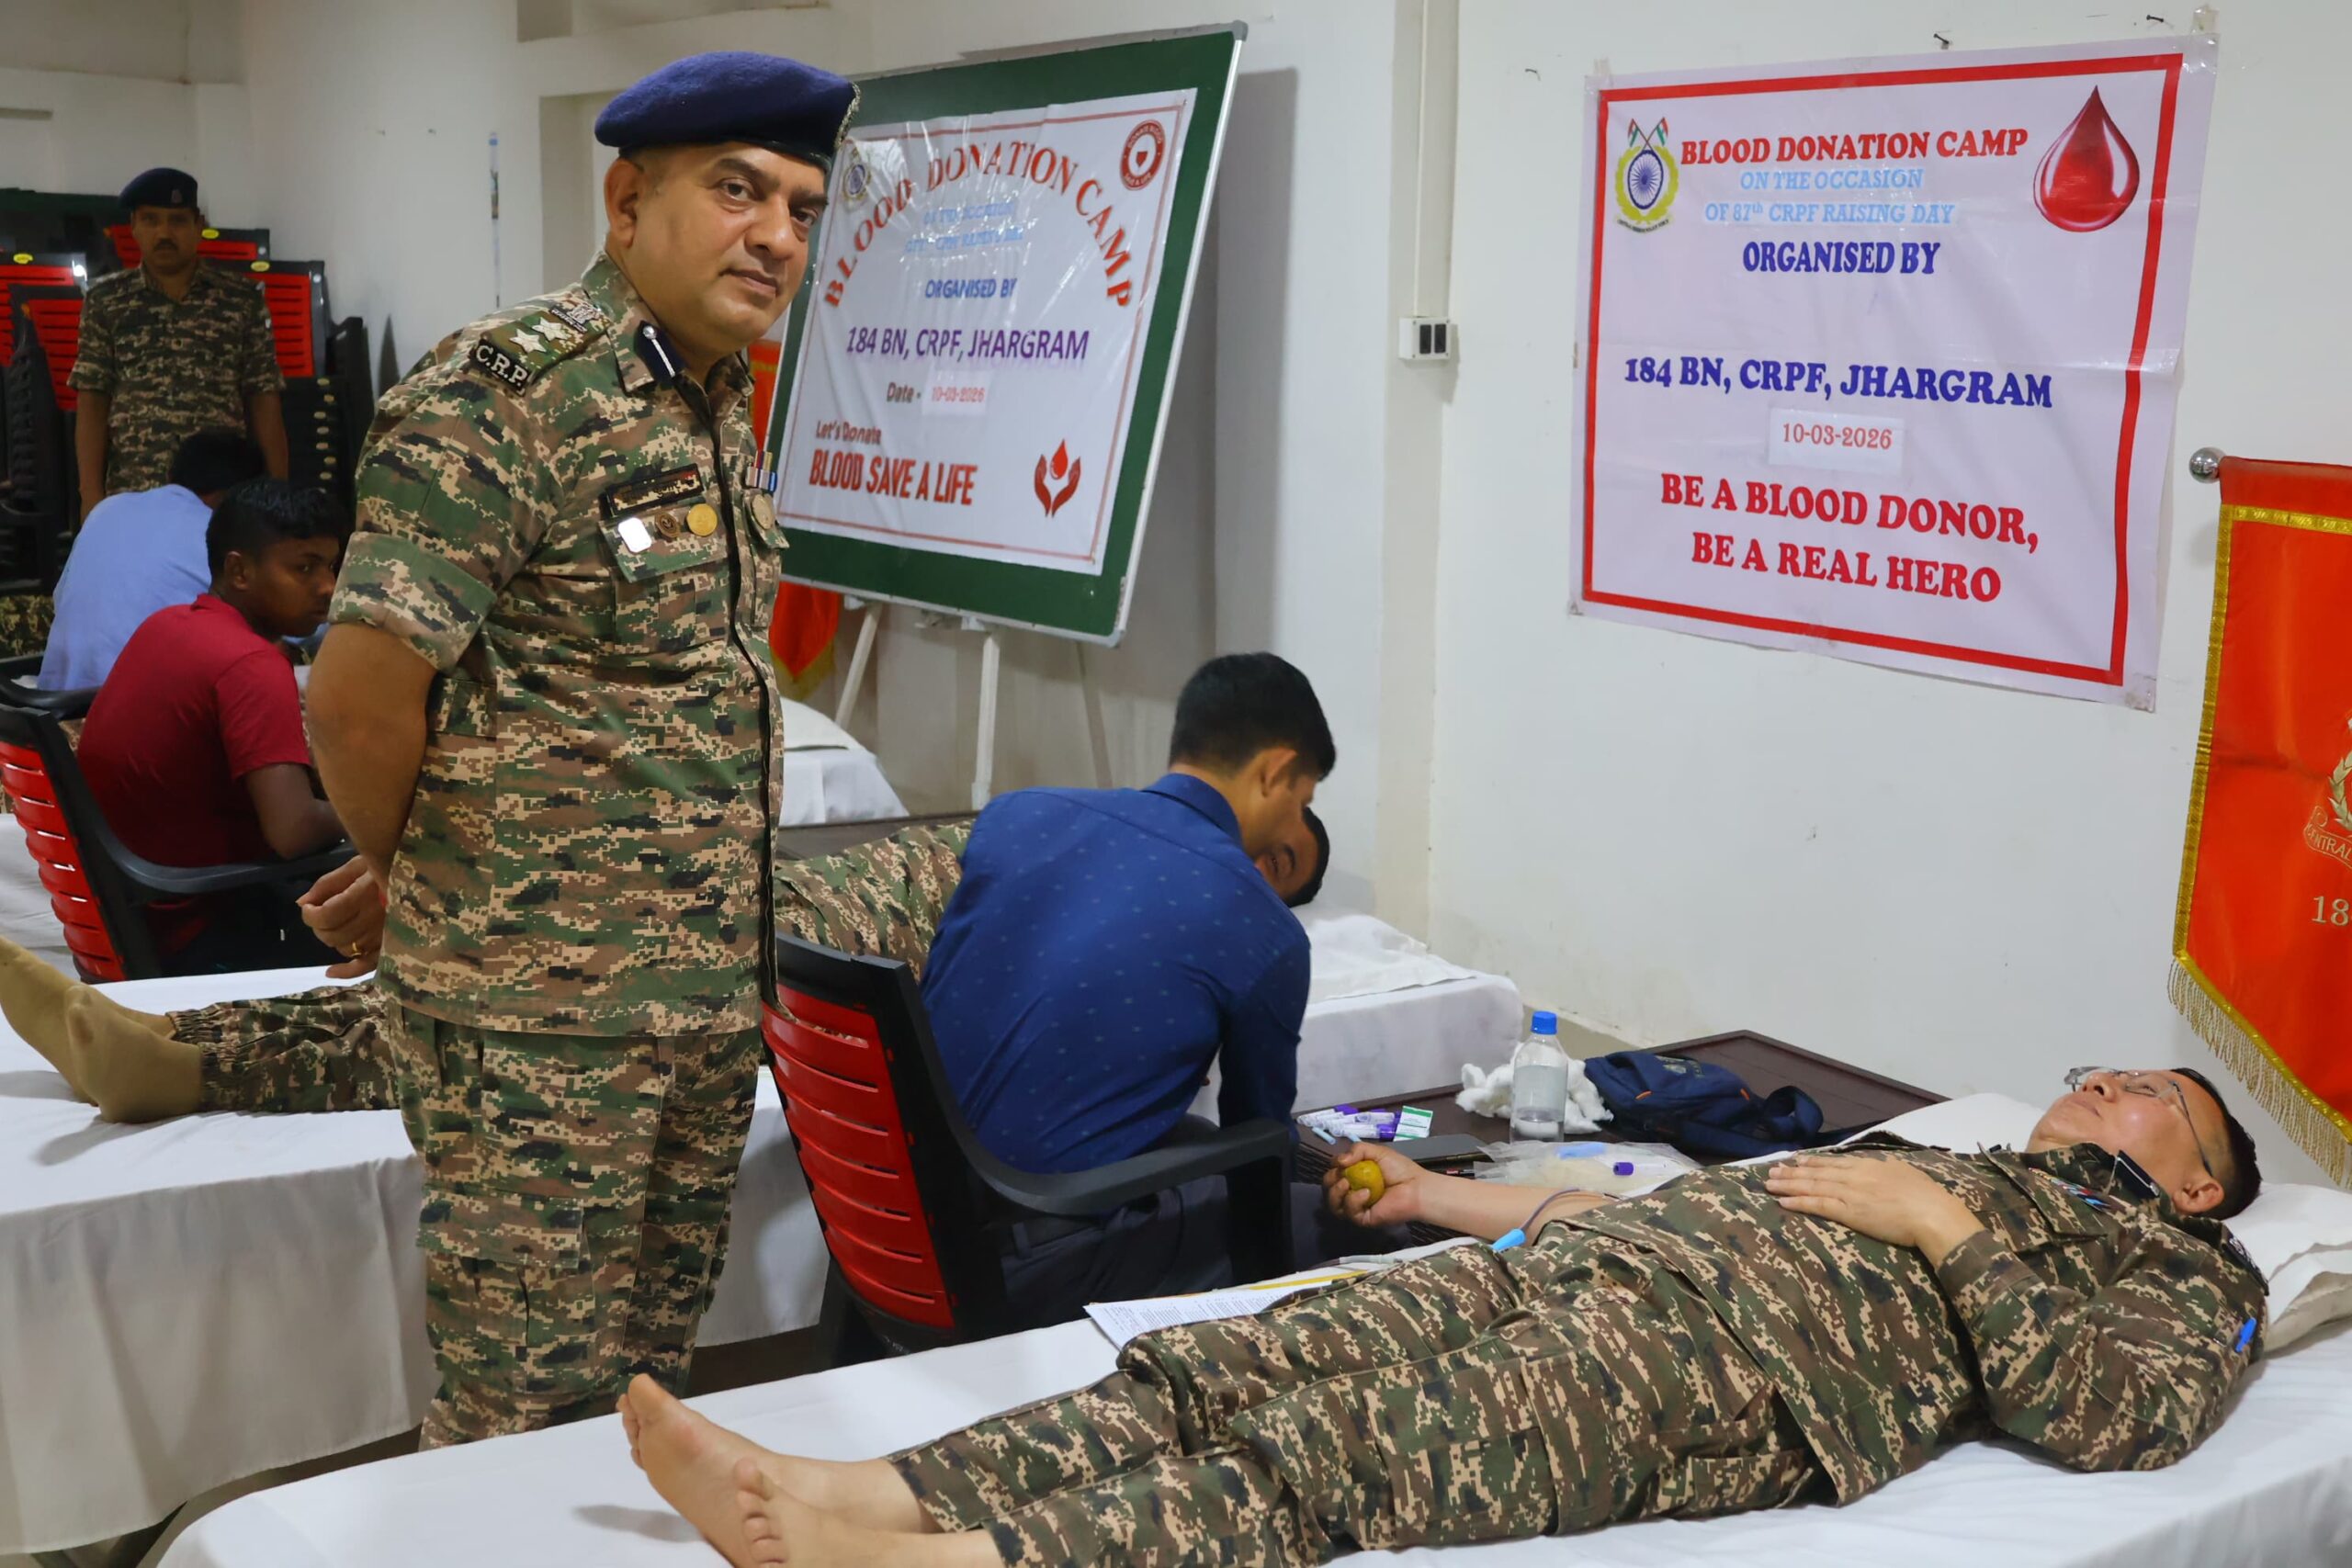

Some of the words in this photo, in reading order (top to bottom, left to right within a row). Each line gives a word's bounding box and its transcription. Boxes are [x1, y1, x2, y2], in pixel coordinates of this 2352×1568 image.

[1680, 138, 1770, 164] BLOOD
[1776, 131, 1930, 162] DONATION
[1936, 129, 2029, 157] CAMP
[1740, 172, 1768, 189] ON
[1773, 172, 1809, 189] THE
[1815, 169, 1924, 188] OCCASION
[825, 178, 911, 308] BLOOD
[927, 141, 1080, 196] DONATION
[1078, 178, 1133, 307] CAMP
[1705, 203, 1728, 220] OF
[1732, 202, 1763, 221] 87th
[1769, 204, 1820, 222] CRPF
[1822, 204, 1905, 223] RAISING
[1911, 205, 1956, 223] DAY
[1743, 242, 1894, 274] ORGANISED
[1900, 243, 1940, 274] BY
[925, 279, 997, 299] ORGANISED
[1001, 278, 1018, 298] BY
[846, 327, 876, 354] 184
[880, 328, 910, 360] BN,
[916, 328, 965, 362] CRPF,
[967, 330, 1090, 360] JHARGRAM
[887, 382, 914, 403] Date
[1625, 357, 1672, 387] 184
[1680, 356, 1731, 394] BN,
[1739, 359, 1831, 400] CRPF,
[1840, 365, 2053, 408] JHARGRAM
[815, 420, 840, 440] Let's
[842, 423, 882, 445] Donate
[1782, 423, 1893, 450] 10-03-2026
[808, 448, 865, 491] BLOOD
[865, 456, 916, 499] SAVE
[915, 460, 930, 501] A
[933, 461, 978, 506] LIFE
[1661, 473, 1704, 508] BE
[1712, 478, 1738, 511] A
[1746, 480, 1868, 525] BLOOD
[1877, 494, 2039, 555] DONOR,
[1691, 532, 1735, 568] BE
[1741, 538, 1769, 571] A
[1777, 541, 1878, 587] REAL
[1886, 556, 2002, 603] HERO
[2312, 896, 2352, 927] 18
